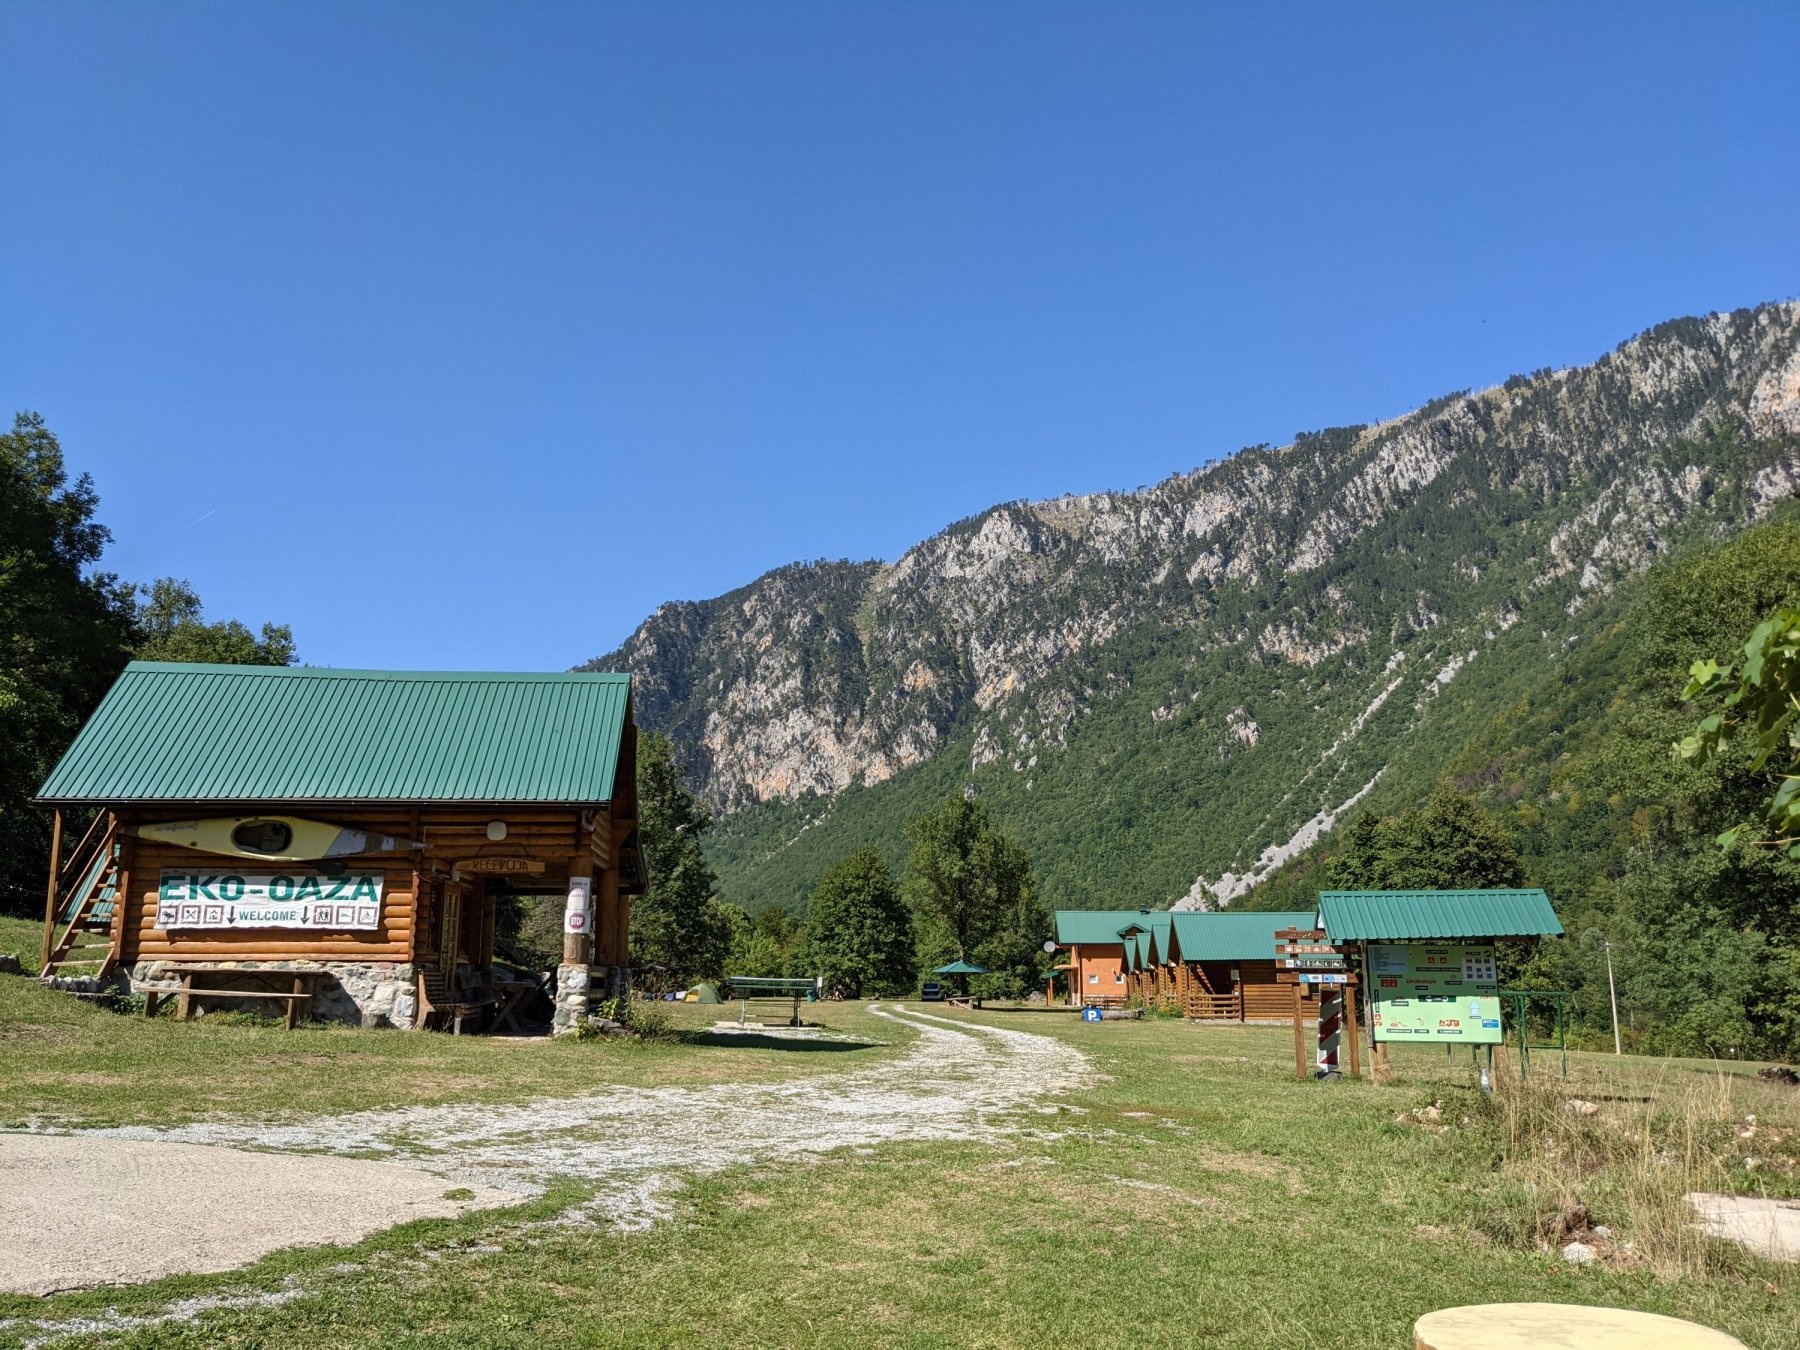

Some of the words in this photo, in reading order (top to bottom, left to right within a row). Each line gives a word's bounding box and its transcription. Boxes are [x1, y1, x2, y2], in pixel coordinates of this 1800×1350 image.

[472, 859, 529, 872] RECEPCIJA
[159, 875, 379, 902] EKO-OAZA
[239, 910, 297, 921] WELCOME
[570, 915, 584, 925] STOP
[1087, 1010, 1097, 1021] P
